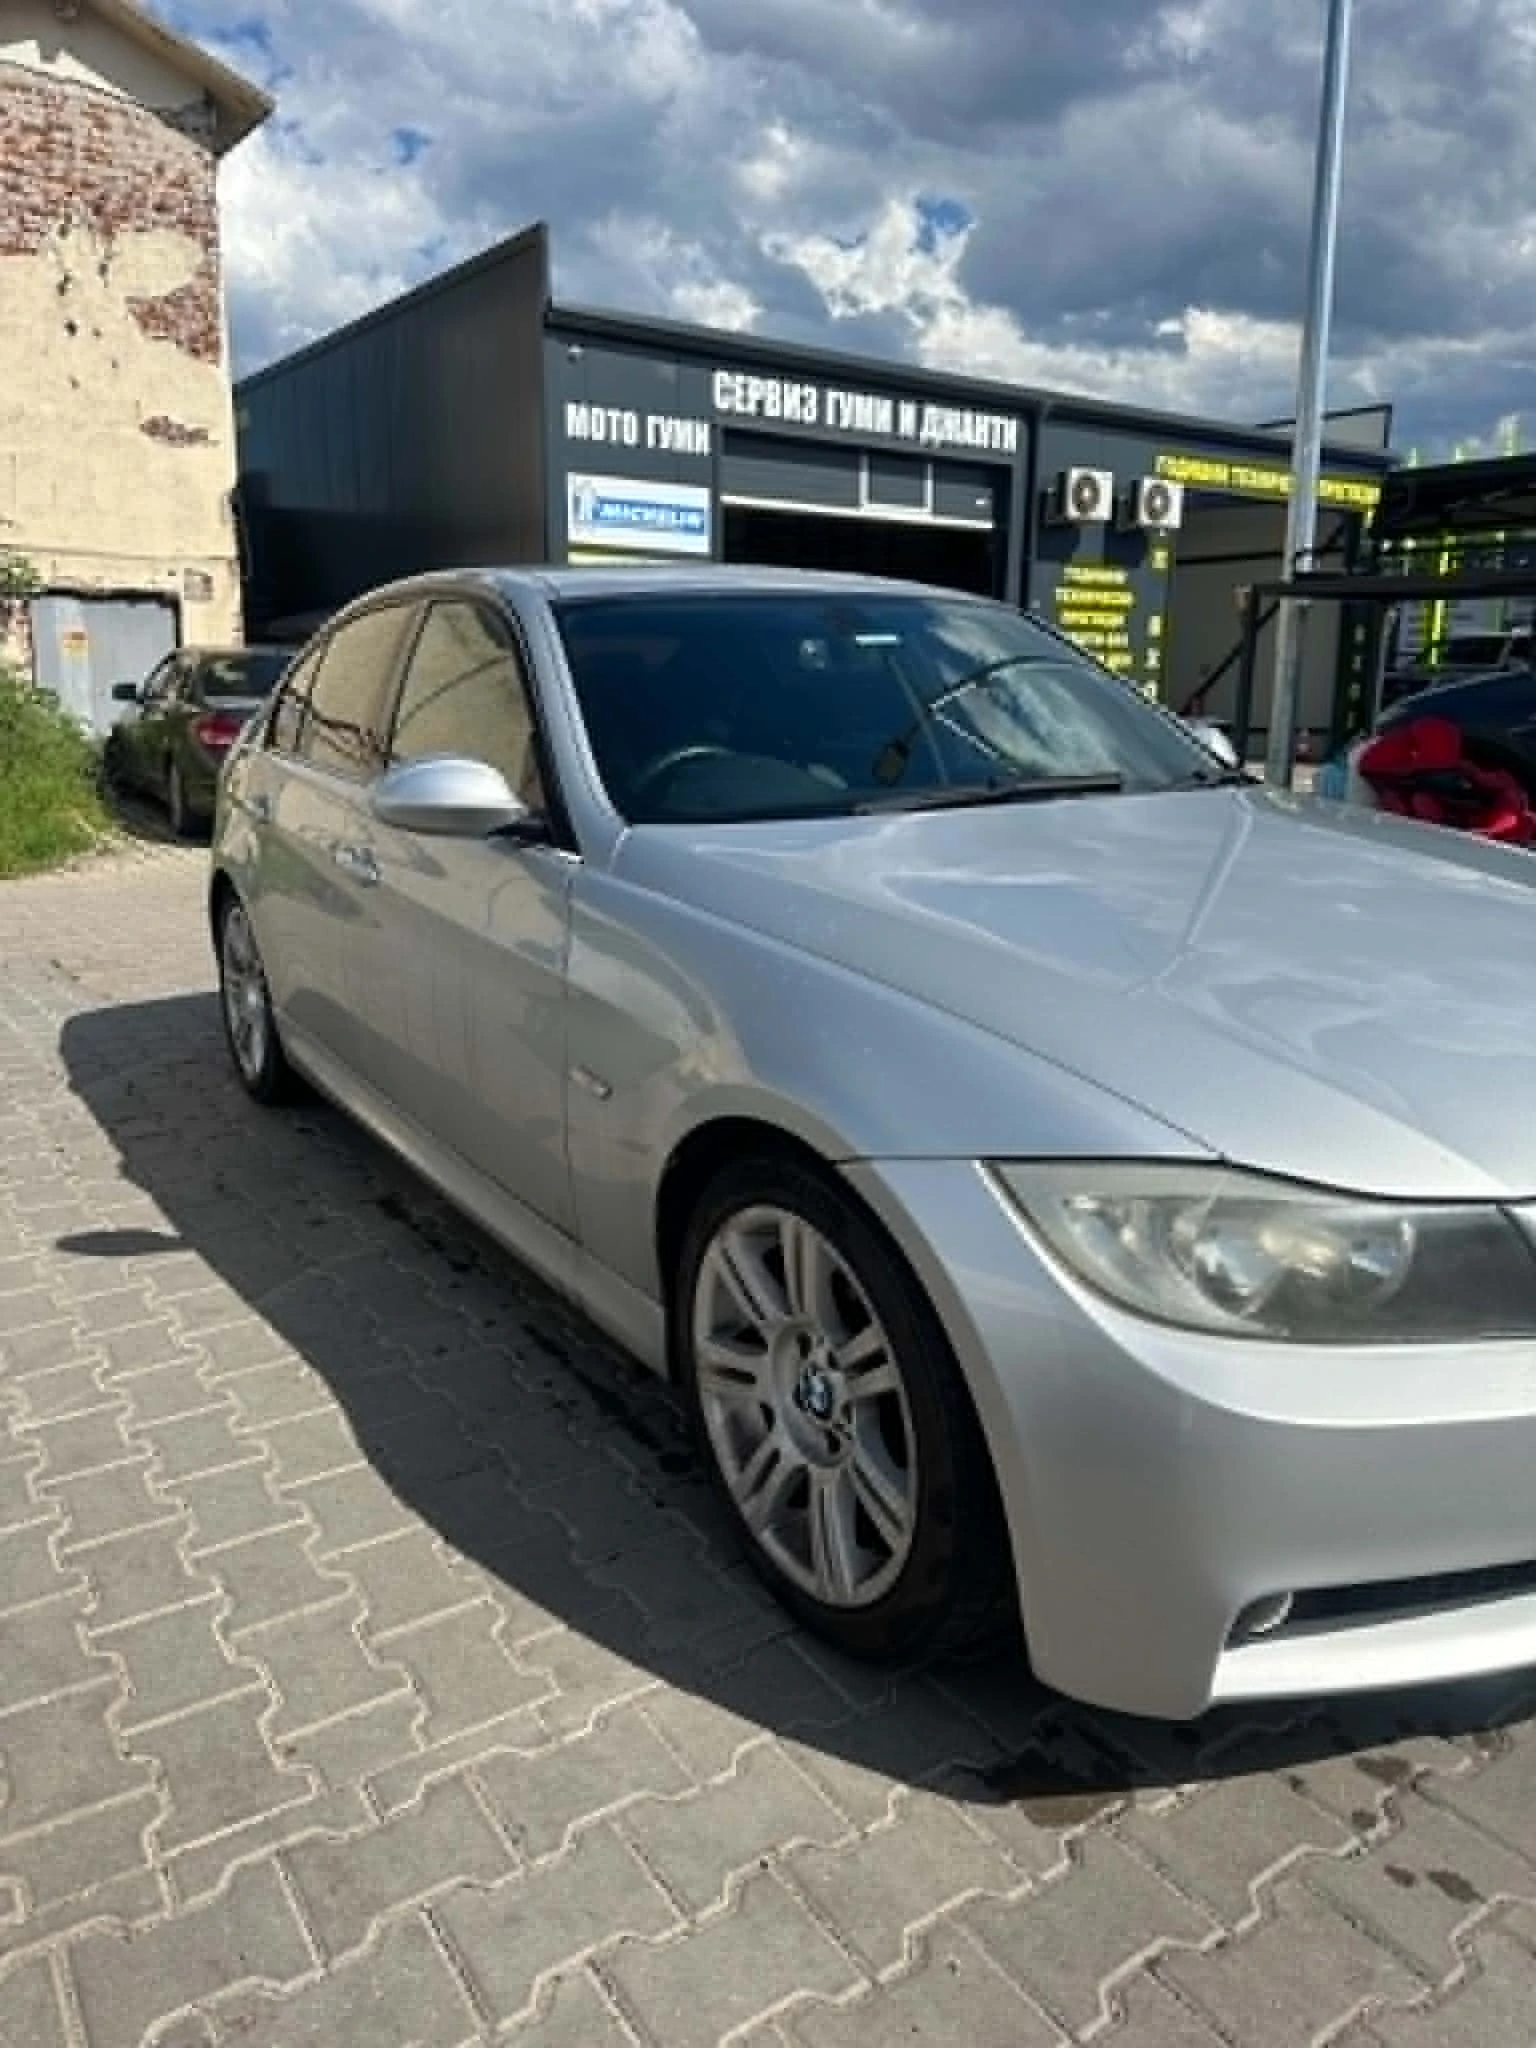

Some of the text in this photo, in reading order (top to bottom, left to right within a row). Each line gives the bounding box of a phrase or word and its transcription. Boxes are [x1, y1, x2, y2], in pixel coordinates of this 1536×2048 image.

[566, 402, 711, 456] МОТО ГУМИ
[713, 370, 1018, 453] СЕРВИЗ ГУМИ И ДЖАНТИ
